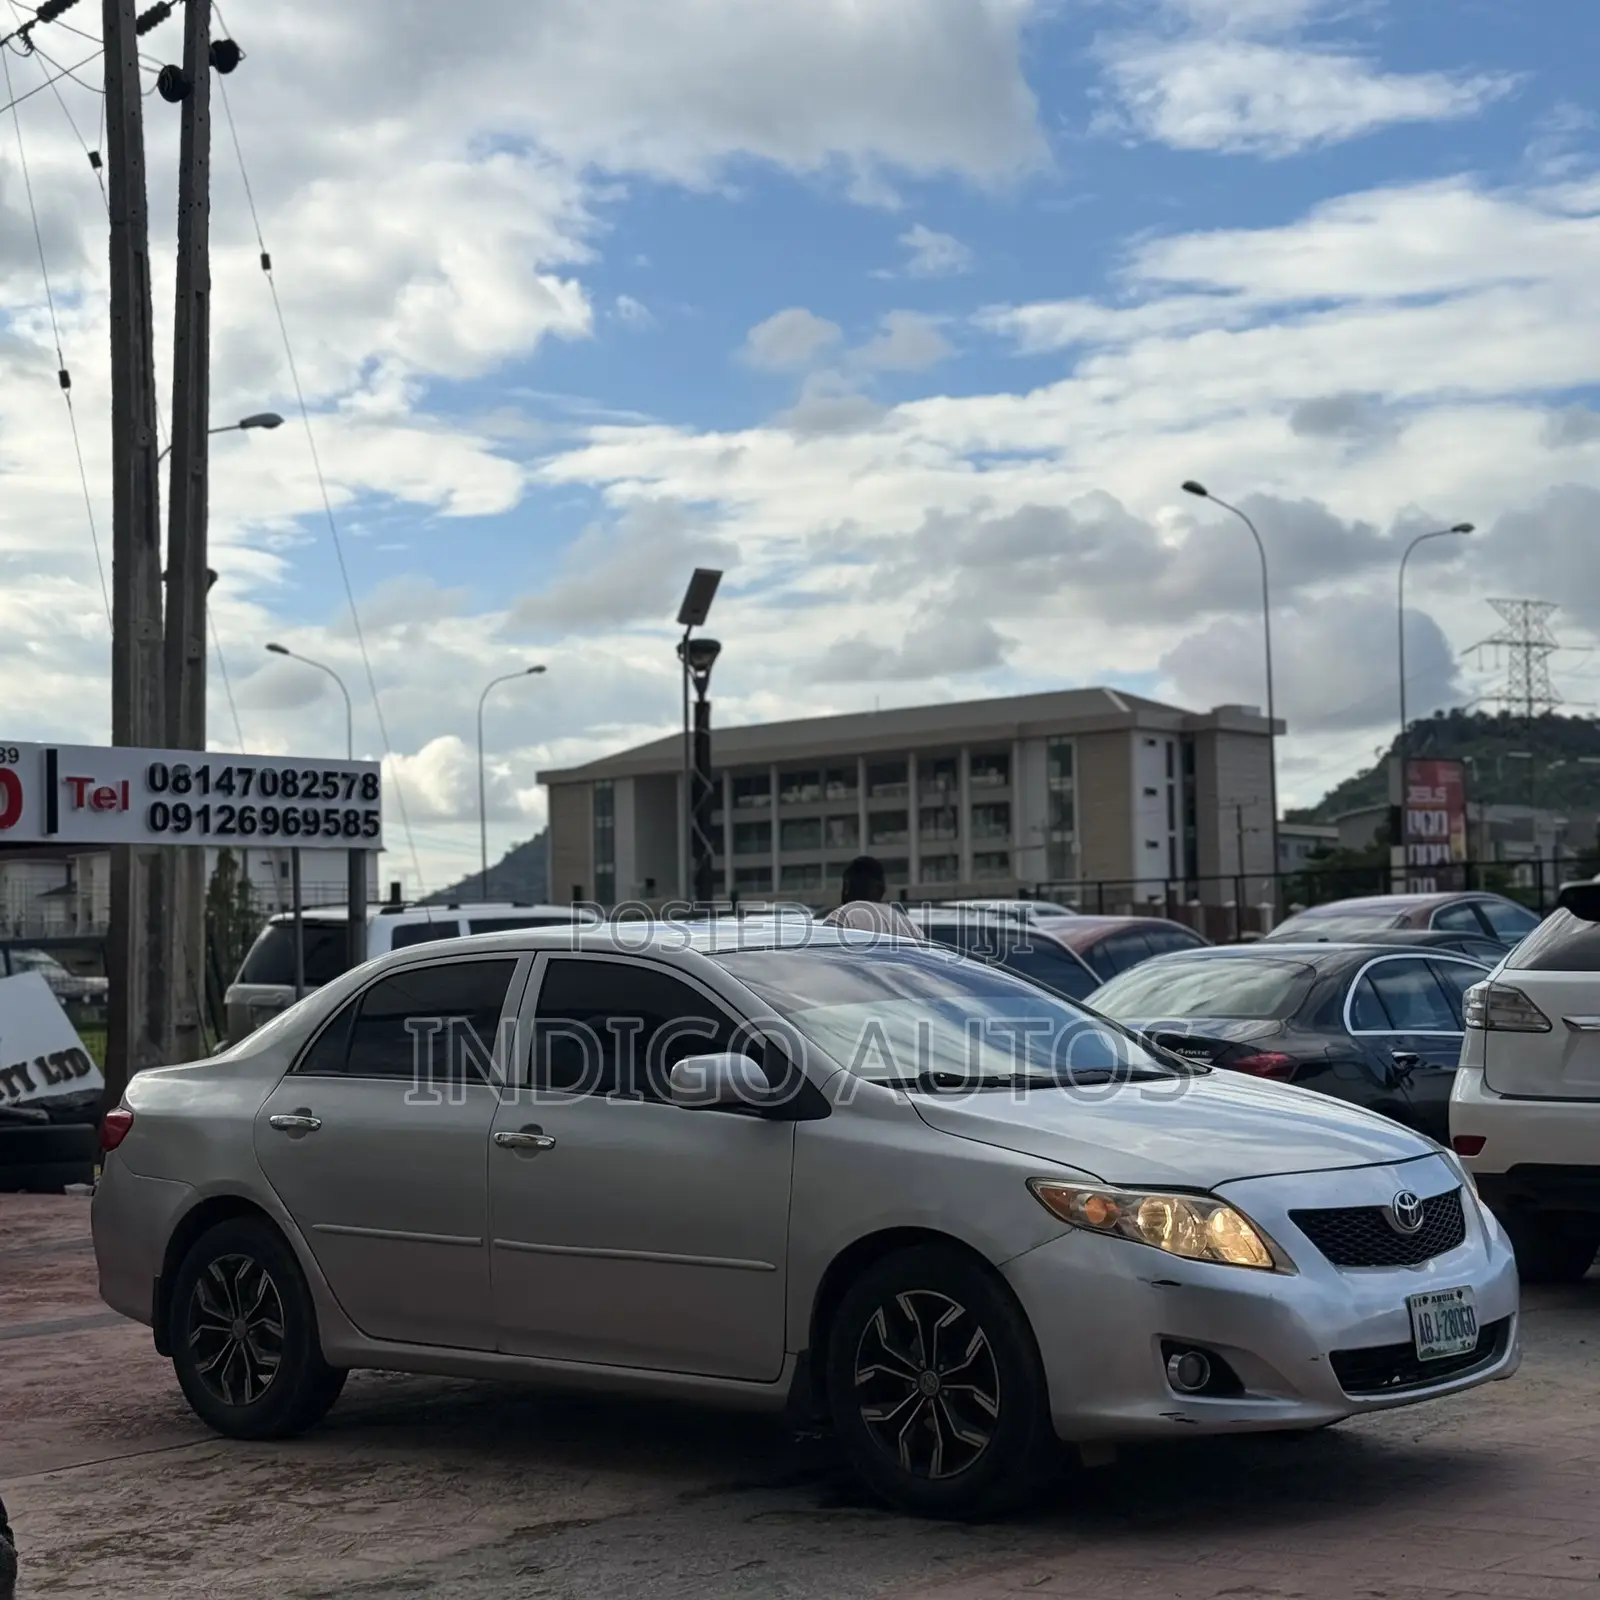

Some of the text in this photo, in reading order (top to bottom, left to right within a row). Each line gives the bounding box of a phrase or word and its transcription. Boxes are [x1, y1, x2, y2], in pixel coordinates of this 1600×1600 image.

[64, 776, 130, 811] Tel
[148, 762, 380, 801] 08147082578
[149, 801, 381, 838] 09126969585
[0, 1047, 91, 1100] TY LTD
